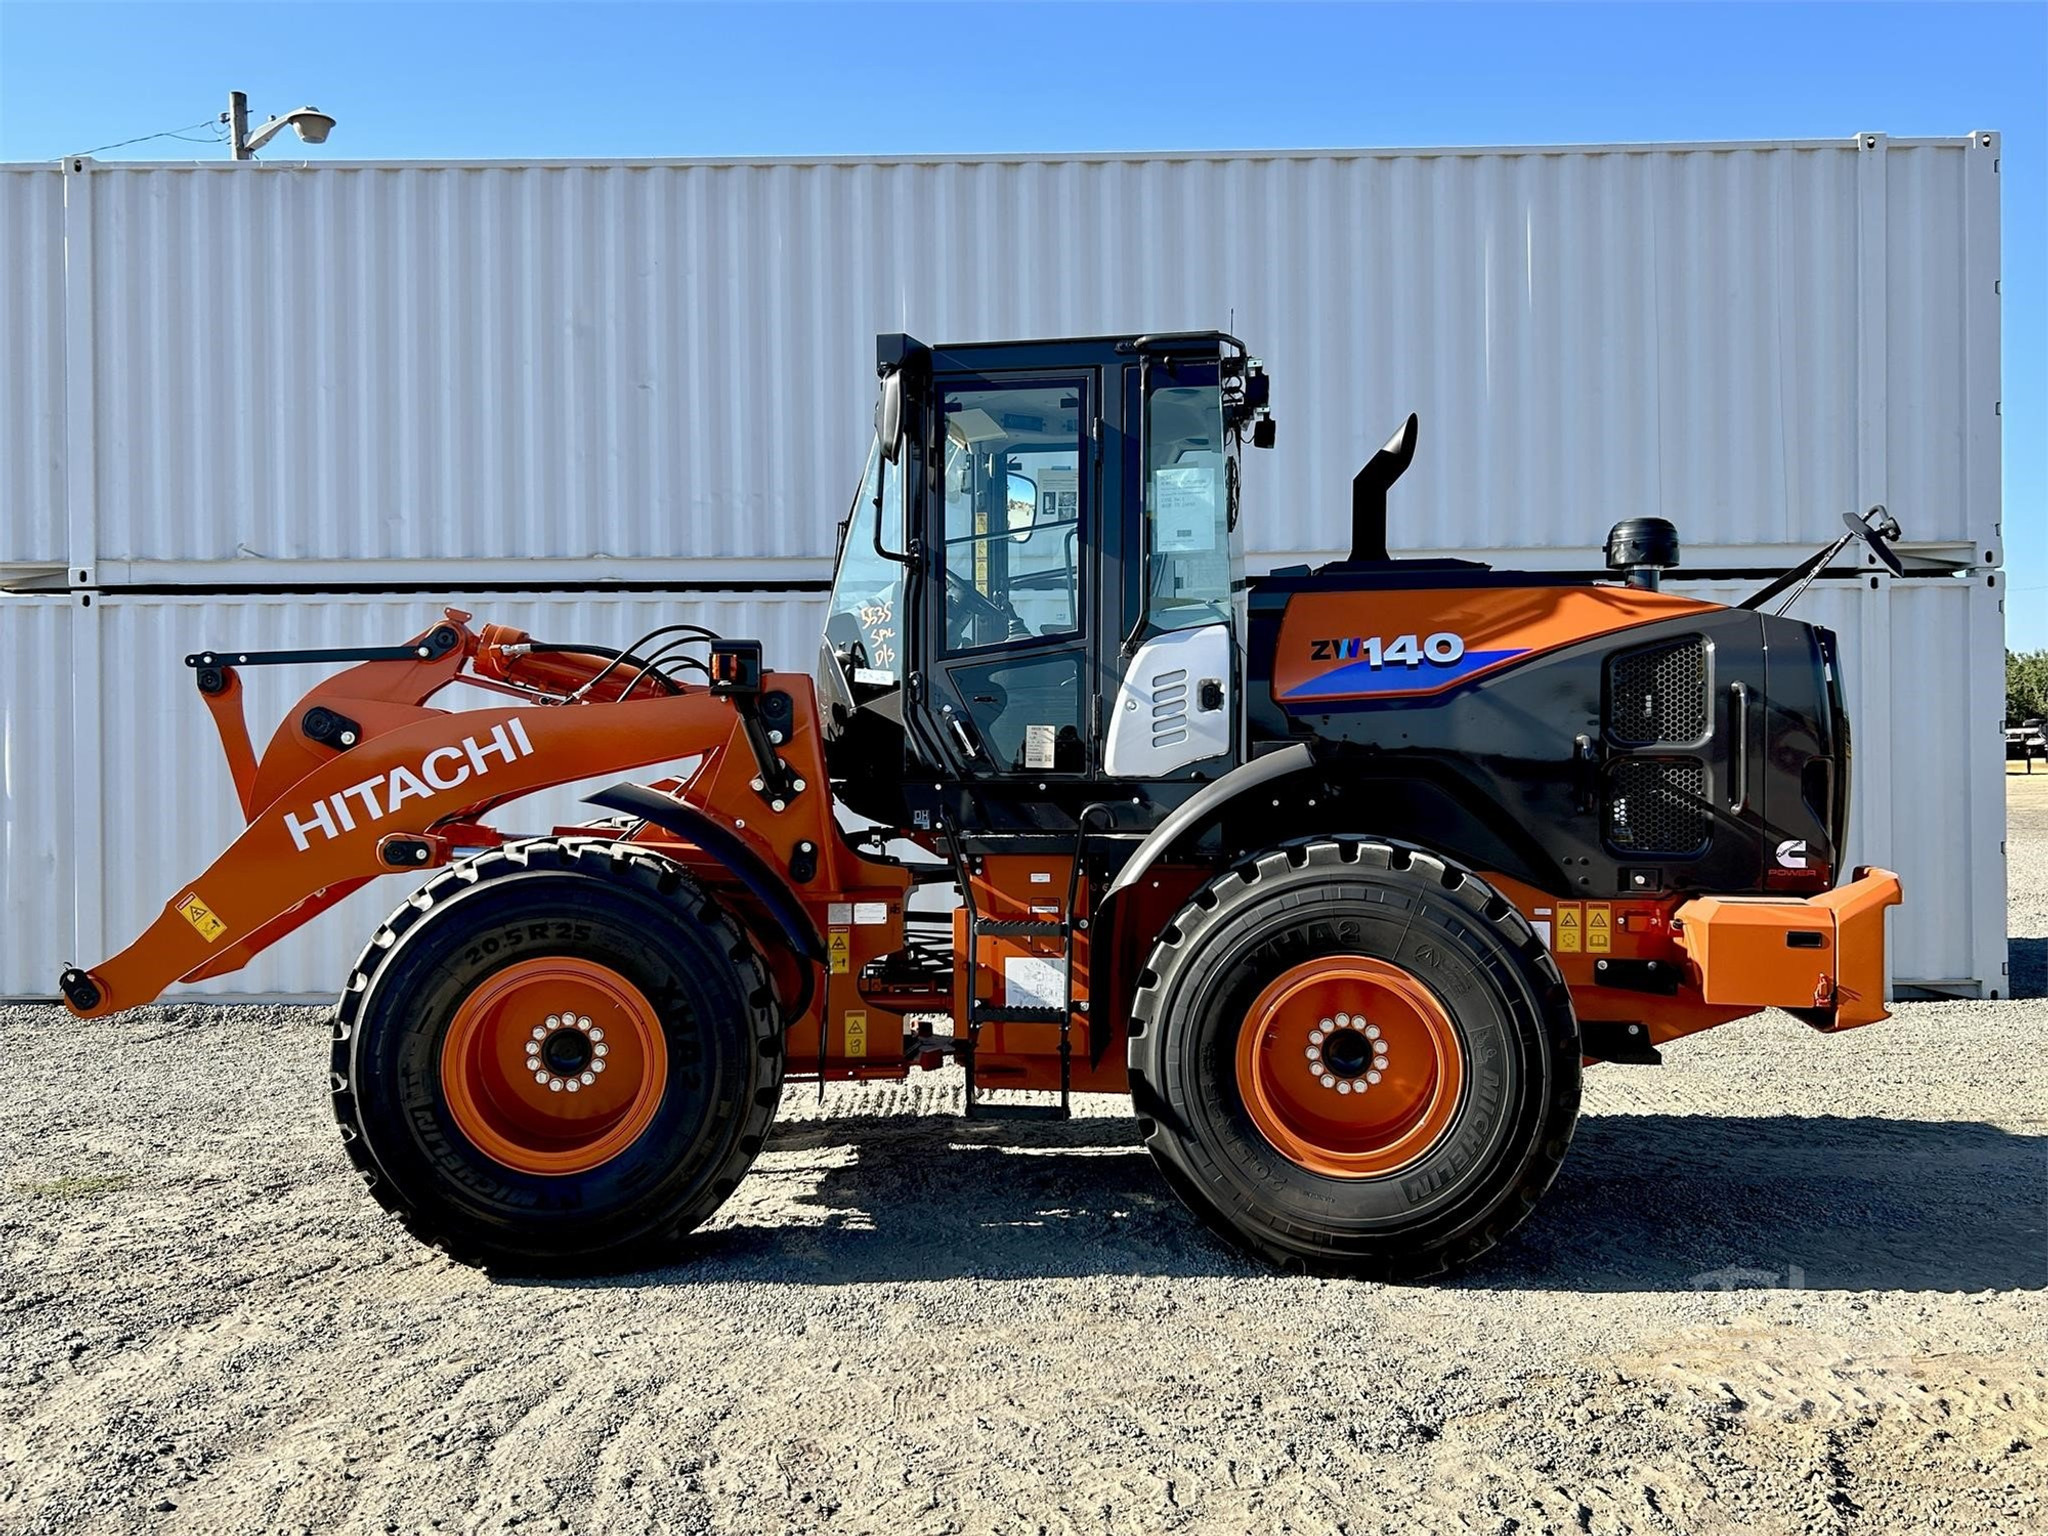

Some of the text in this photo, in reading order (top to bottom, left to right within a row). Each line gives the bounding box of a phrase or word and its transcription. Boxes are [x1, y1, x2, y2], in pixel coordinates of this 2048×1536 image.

[283, 716, 534, 852] HITACHI
[1768, 869, 1817, 877] POWER
[413, 1110, 538, 1206] MICHELIN
[1407, 1067, 1499, 1202] MICHELIN
